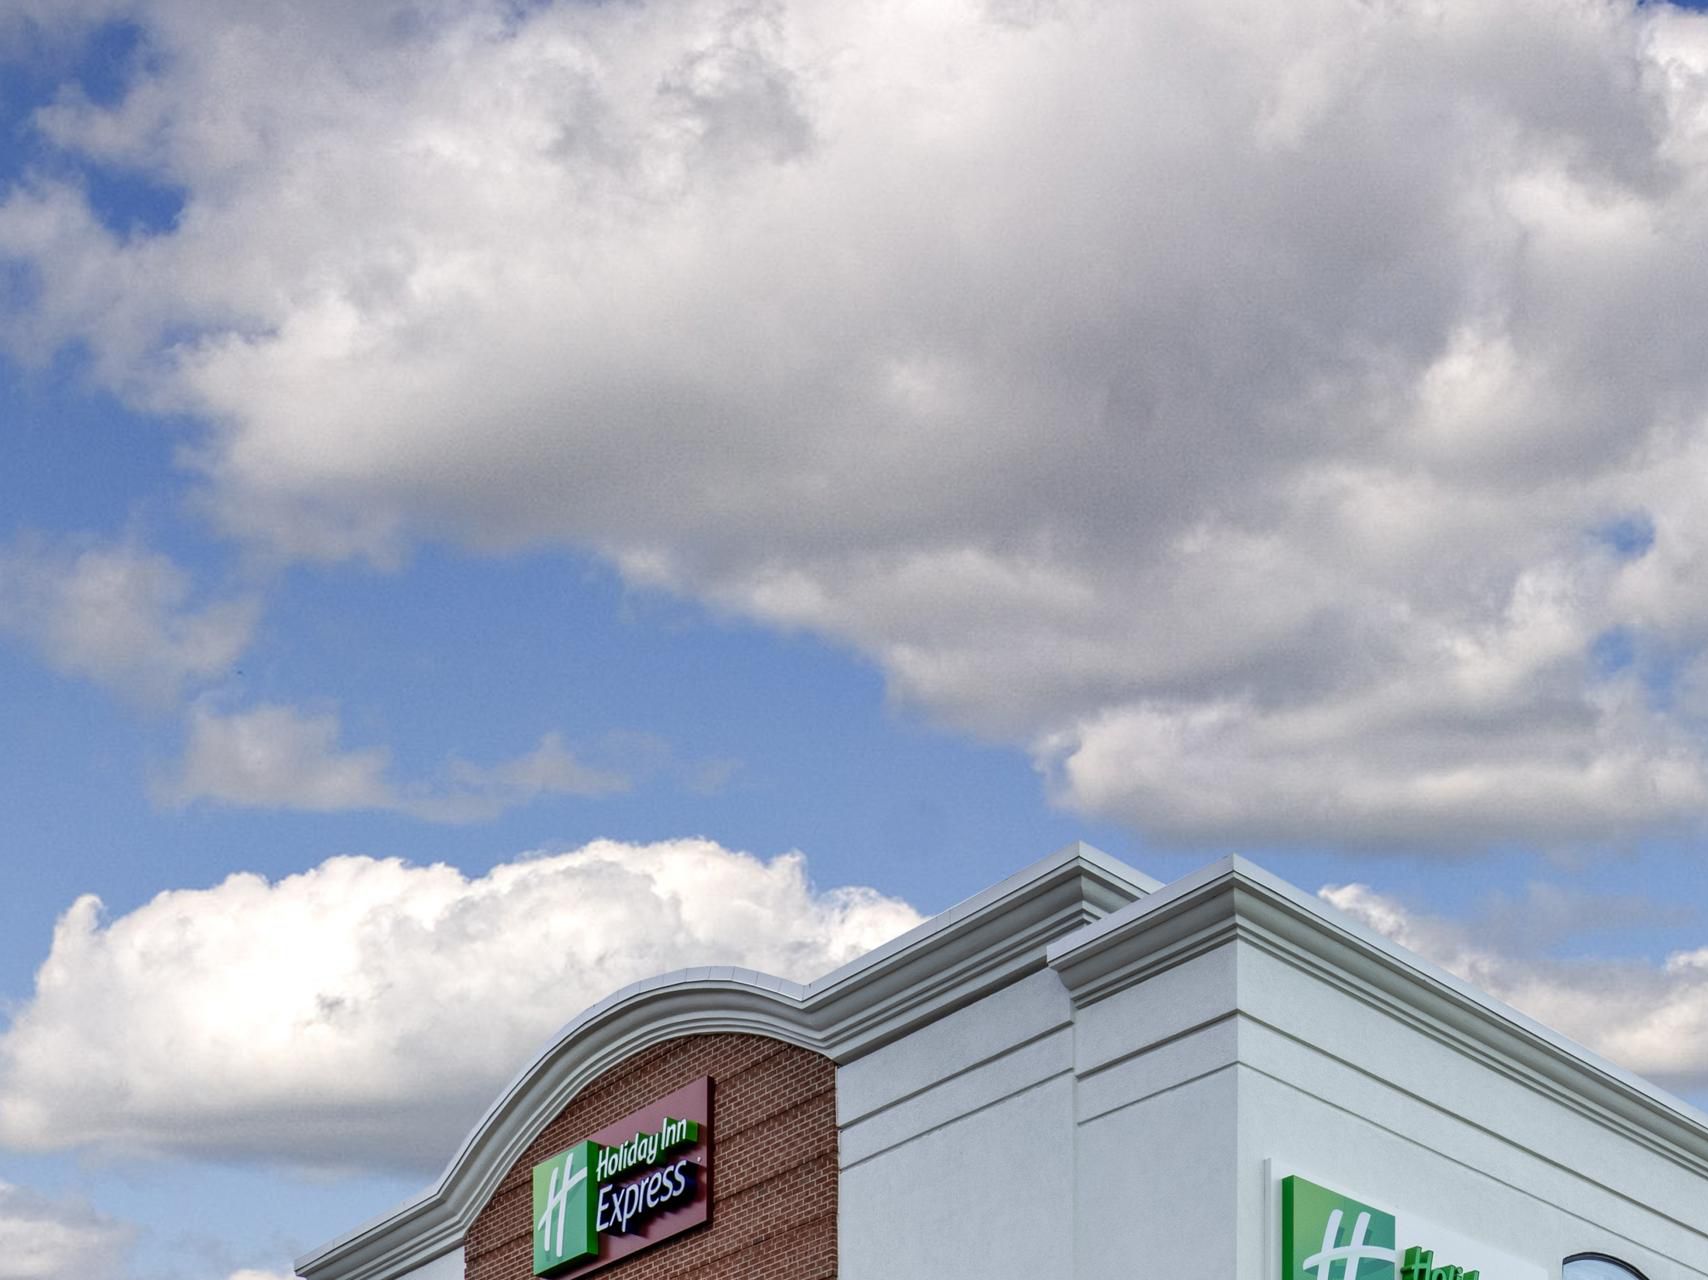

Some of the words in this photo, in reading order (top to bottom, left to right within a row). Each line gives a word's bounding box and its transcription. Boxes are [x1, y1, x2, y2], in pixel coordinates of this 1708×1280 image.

[596, 1131, 659, 1182] Holiday
[660, 1117, 688, 1150] Inn
[596, 1160, 687, 1233] Express
